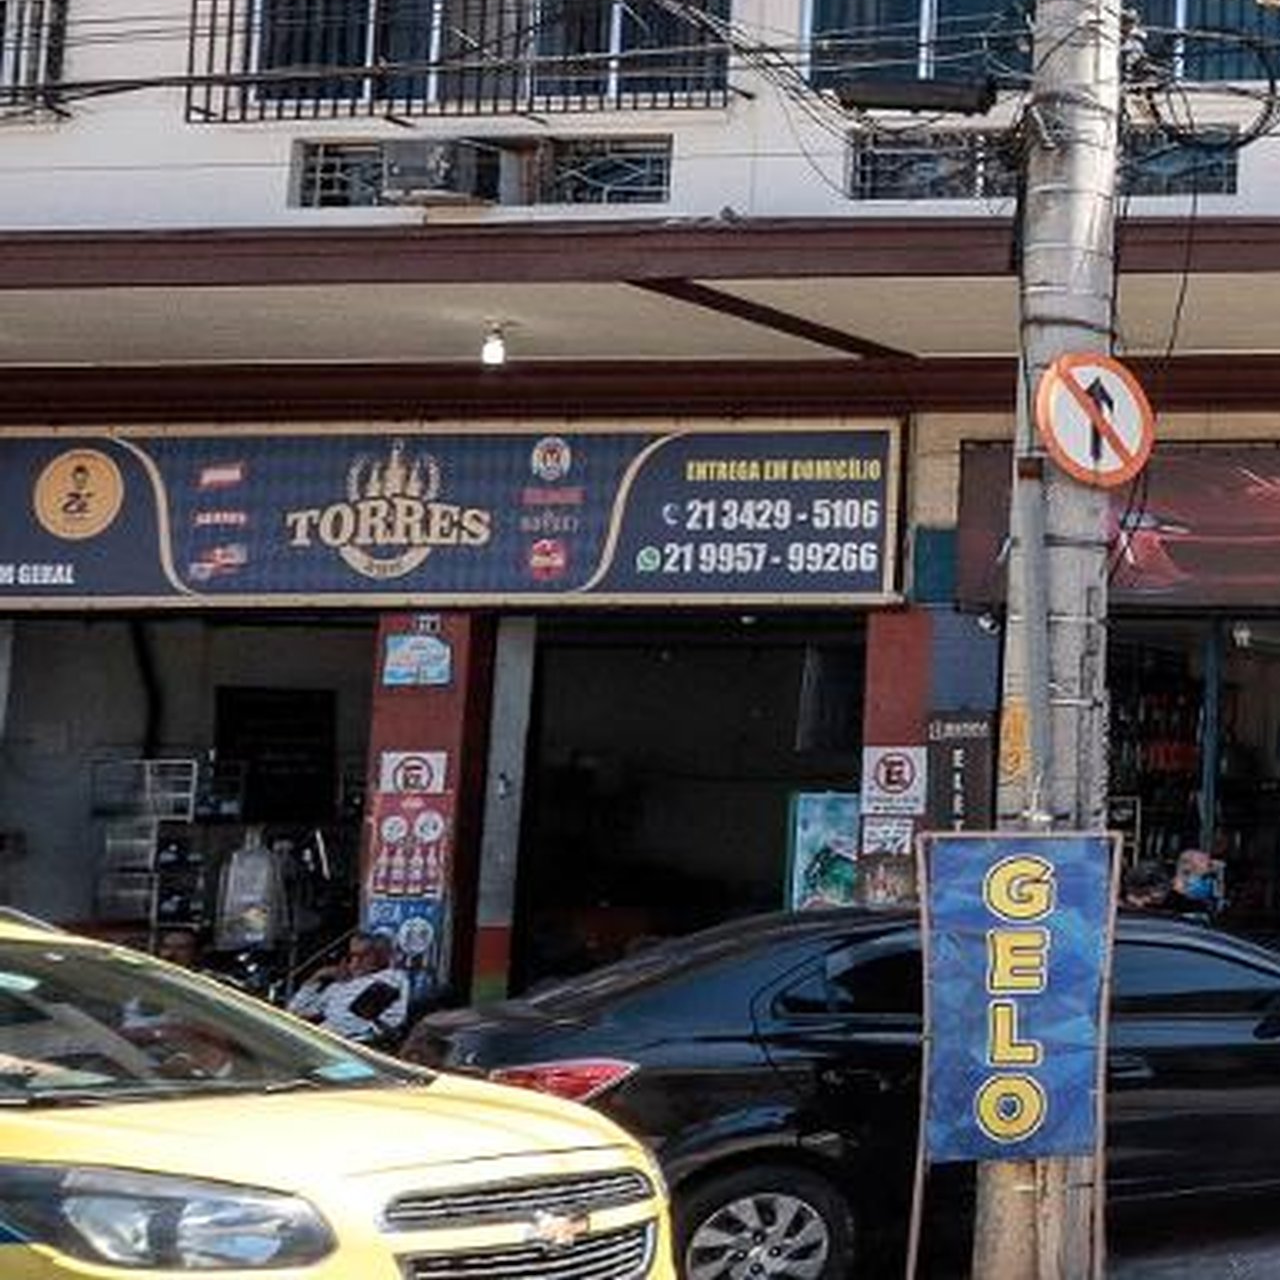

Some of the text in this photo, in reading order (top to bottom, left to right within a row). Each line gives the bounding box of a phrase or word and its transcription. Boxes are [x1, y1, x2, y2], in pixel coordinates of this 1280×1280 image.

[687, 460, 760, 480] ENTREGA
[764, 460, 791, 480] EM
[286, 495, 491, 548] TORRES
[685, 499, 715, 530] 21
[722, 499, 791, 530] 3429
[812, 499, 880, 530] 5106
[662, 542, 694, 573] 21
[699, 542, 768, 572] 9957
[788, 542, 879, 572] 99266
[18, 563, 75, 584] GERAL
[885, 759, 904, 784] E
[973, 854, 1057, 1144] GELO
